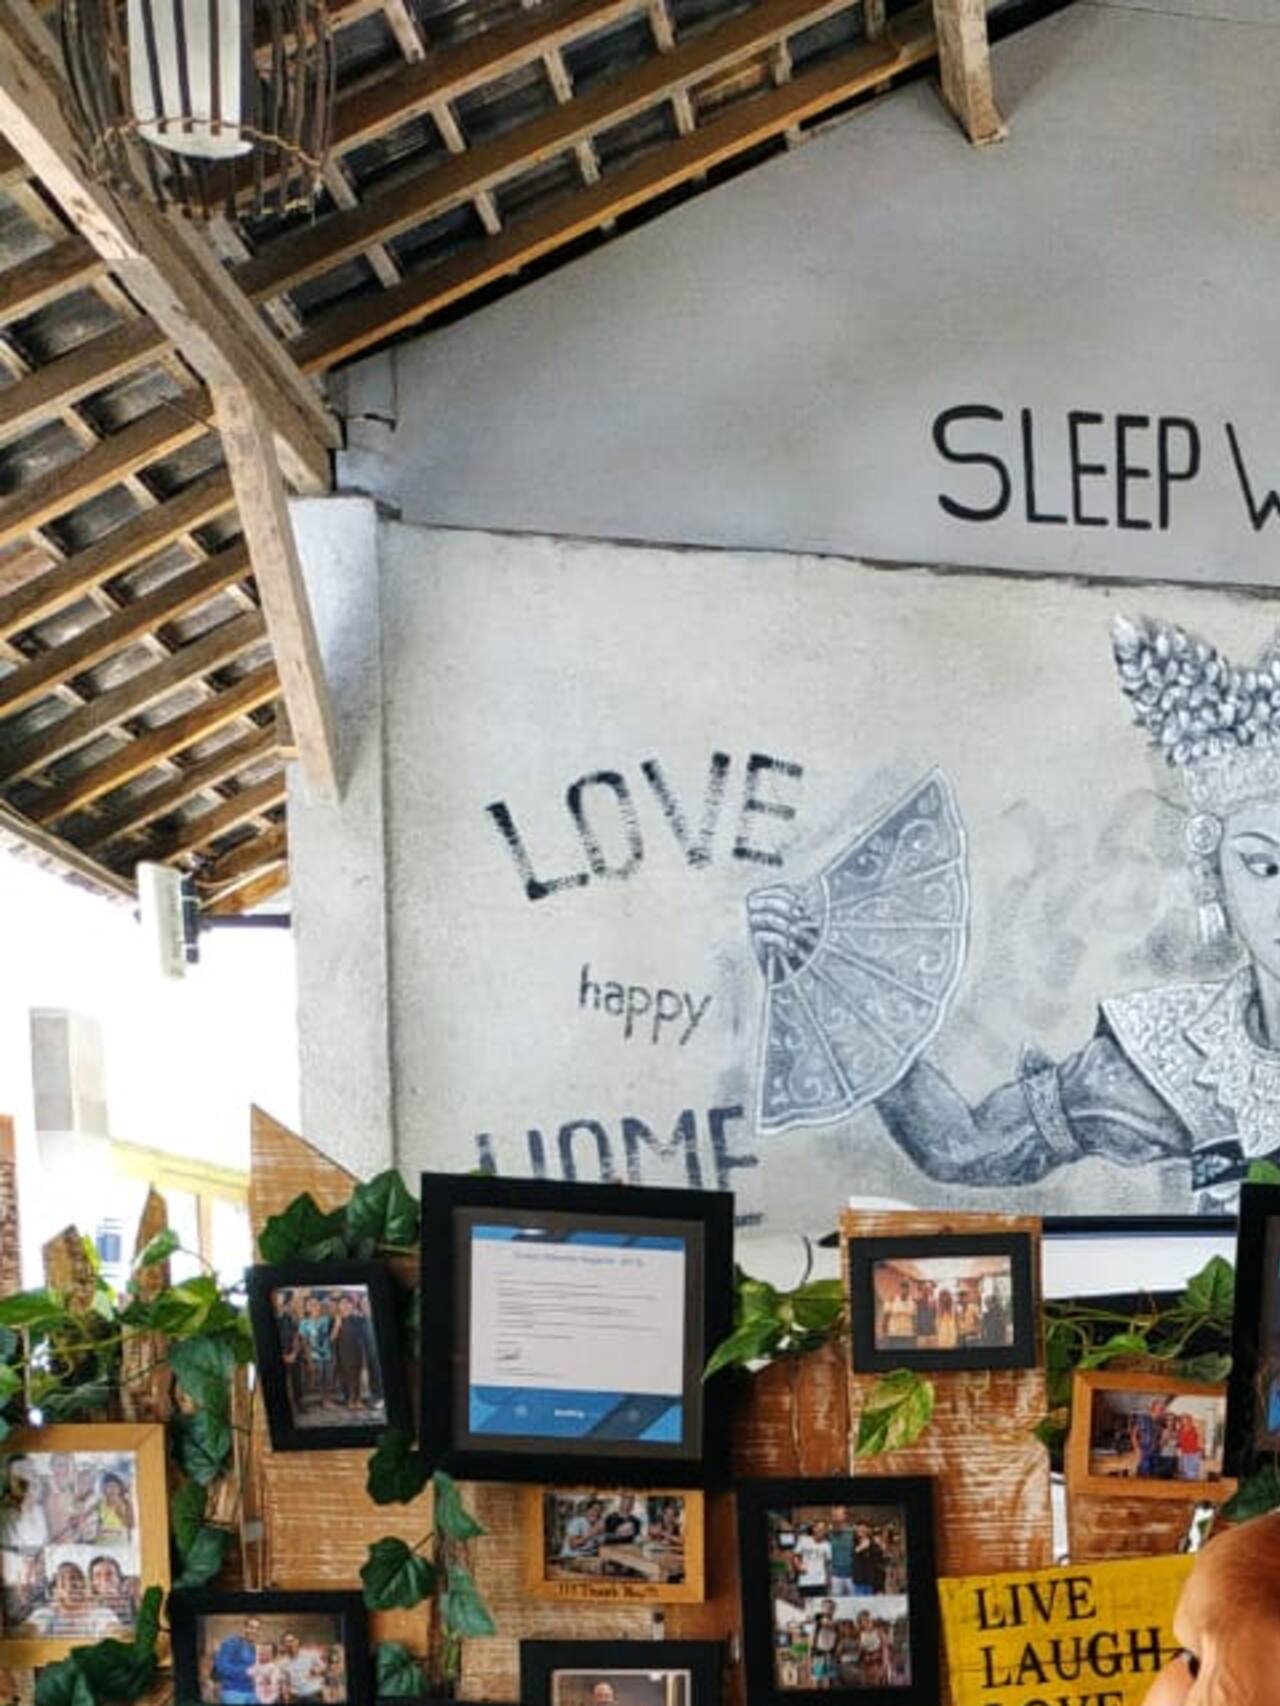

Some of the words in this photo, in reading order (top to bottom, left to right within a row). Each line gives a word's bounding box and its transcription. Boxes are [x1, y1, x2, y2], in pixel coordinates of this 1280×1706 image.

[932, 404, 1201, 531] SLEEP
[485, 751, 804, 901] LOVE
[579, 963, 712, 1046] happy
[974, 1576, 1097, 1632] LIVE
[979, 1627, 1163, 1690] LAUGH
